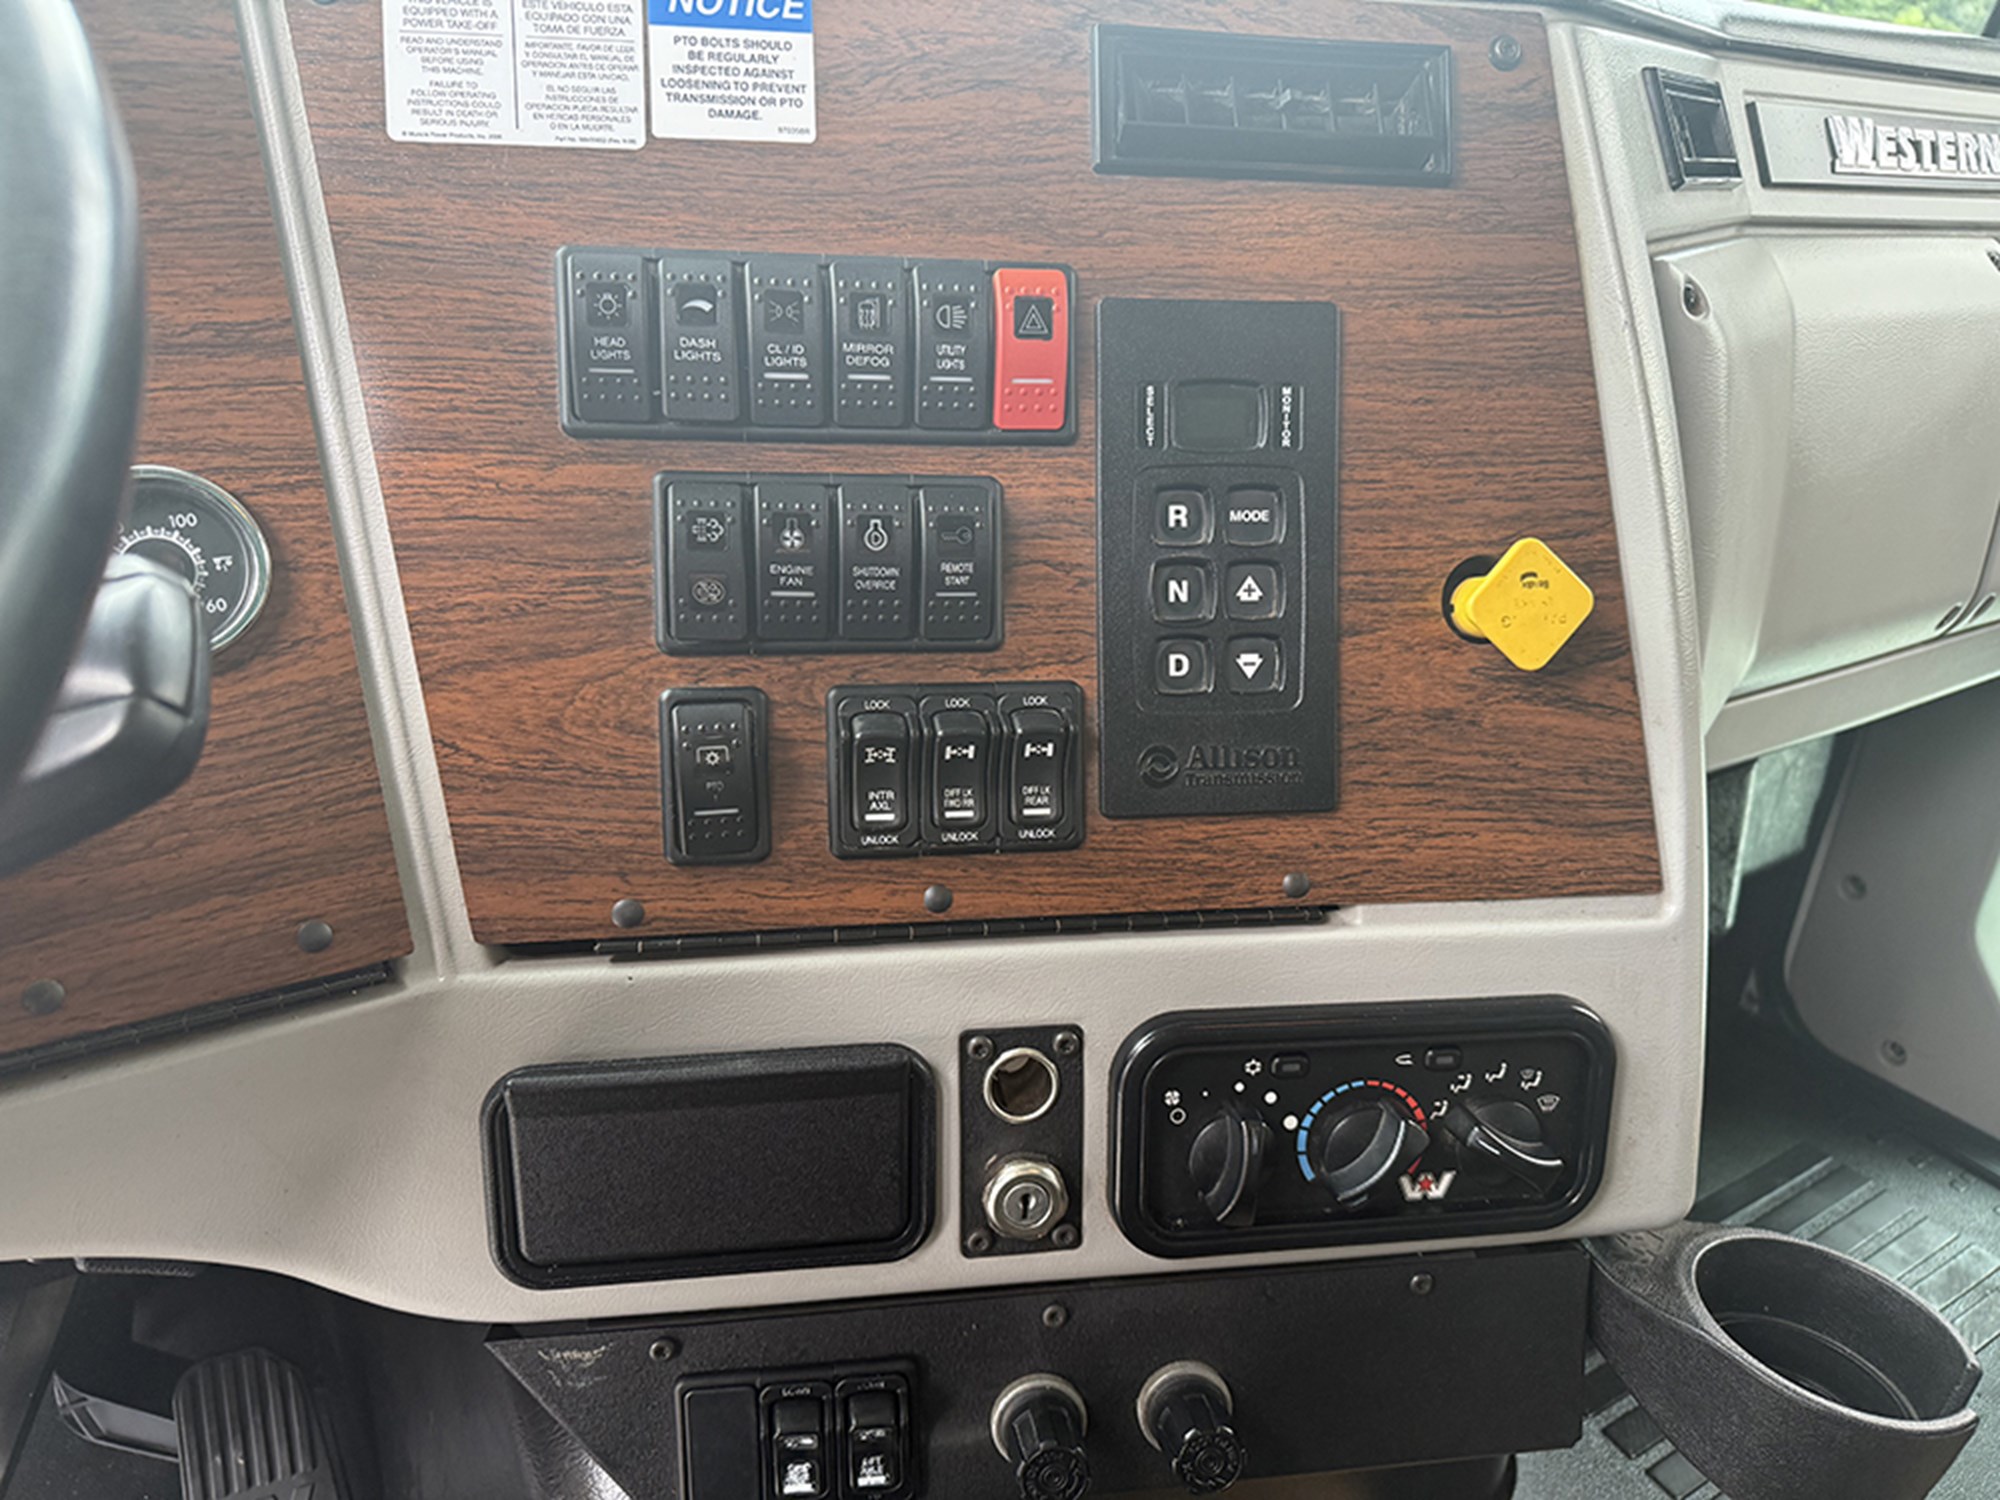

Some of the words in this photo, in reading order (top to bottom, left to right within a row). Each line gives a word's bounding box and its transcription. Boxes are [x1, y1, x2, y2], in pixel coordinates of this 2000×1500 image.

[402, 6, 458, 17] EQUIPPED
[460, 8, 488, 17] WITH
[490, 10, 498, 19] A
[668, 0, 804, 20] NOTICE
[402, 18, 444, 28] POWER
[525, 11, 579, 23] EQUIPADO
[582, 14, 606, 24] CON
[608, 16, 632, 25] UNA
[533, 23, 564, 33] TOMA
[566, 24, 580, 34] DE
[400, 36, 424, 44] READ
[426, 37, 444, 45] AND
[446, 38, 503, 48] UNDERSTAND
[576, 43, 601, 52] FAVOR
[604, 44, 613, 52] DE
[674, 35, 697, 46] PTO
[701, 37, 740, 49] BOLTS
[743, 38, 792, 51] SHOULD
[420, 56, 454, 64] BEFORE
[456, 57, 484, 65] USING
[532, 51, 578, 60] CONSULTAR
[580, 52, 588, 61] EL
[624, 55, 634, 63] DE
[687, 50, 704, 61] BE
[708, 51, 780, 64] REGULARLY
[421, 65, 440, 73] THIS
[569, 62, 593, 70] ANTES
[595, 63, 605, 71] DE
[672, 64, 740, 77] INSPECTED
[743, 67, 795, 79] AGAINST
[429, 80, 463, 88] FAILURE
[466, 81, 478, 90] TO
[557, 85, 570, 93] NO
[571, 85, 599, 94] SEGUIR
[601, 86, 617, 94] LAS
[660, 78, 731, 91] LOOSENING
[733, 81, 749, 92] TO
[752, 82, 807, 94] PREVENT
[411, 89, 446, 98] FOLLOW
[448, 90, 496, 100] OPERATING
[545, 94, 606, 103] INSTRUCCIONES
[666, 92, 756, 106] TRANSMISSION
[758, 96, 776, 107] OR
[780, 98, 804, 108] PTO
[407, 99, 469, 108] INSTRUCTIONS
[471, 100, 502, 109] COULD
[411, 108, 443, 116] RESULT
[456, 110, 483, 118] DEATH
[485, 110, 498, 118] OR
[581, 114, 631, 123] PERSONALES
[708, 108, 763, 121] DAMAGE.
[420, 118, 457, 126] SERIOUS
[570, 123, 579, 131] LA
[1824, 115, 2000, 174] WESTERN
[593, 336, 626, 348] HEAD
[679, 337, 716, 349] DASH
[842, 342, 894, 355] MIRROR
[936, 344, 967, 356] UTILITY
[590, 349, 631, 361] LIGHTS
[674, 350, 721, 363] LIGHTS
[764, 357, 807, 368] LIGHTS
[845, 355, 890, 368] DEFOG
[936, 359, 965, 370] LIGHTS
[1145, 385, 1155, 447] SELECT
[1281, 386, 1292, 448] MONITOR
[168, 512, 198, 529] 100
[1168, 504, 1188, 528] R
[1229, 509, 1270, 522] MODE
[769, 564, 814, 577] ENGINE
[852, 565, 900, 578] SHUTDOWN
[940, 562, 974, 574] REMOTE
[779, 576, 803, 587] FAN
[854, 579, 897, 591] OVERRIDE
[944, 575, 971, 586] START
[1168, 579, 1189, 603] N
[205, 597, 228, 614] 60
[1168, 653, 1190, 677] D
[864, 700, 891, 710] LOCK
[945, 698, 971, 708] LOCK
[1023, 696, 1049, 706] LOCK
[1183, 744, 1300, 770] Allison
[868, 790, 895, 800] INTR
[944, 788, 961, 797] DIFF
[962, 788, 973, 797] LK
[1022, 786, 1039, 795] DIFF
[1040, 786, 1051, 795] LK
[869, 801, 892, 811] AXL
[1024, 796, 1050, 806] REAR
[941, 831, 979, 842] UNLOCK
[1018, 829, 1056, 839] UNLOCK
[861, 835, 899, 846] UNLOCK
